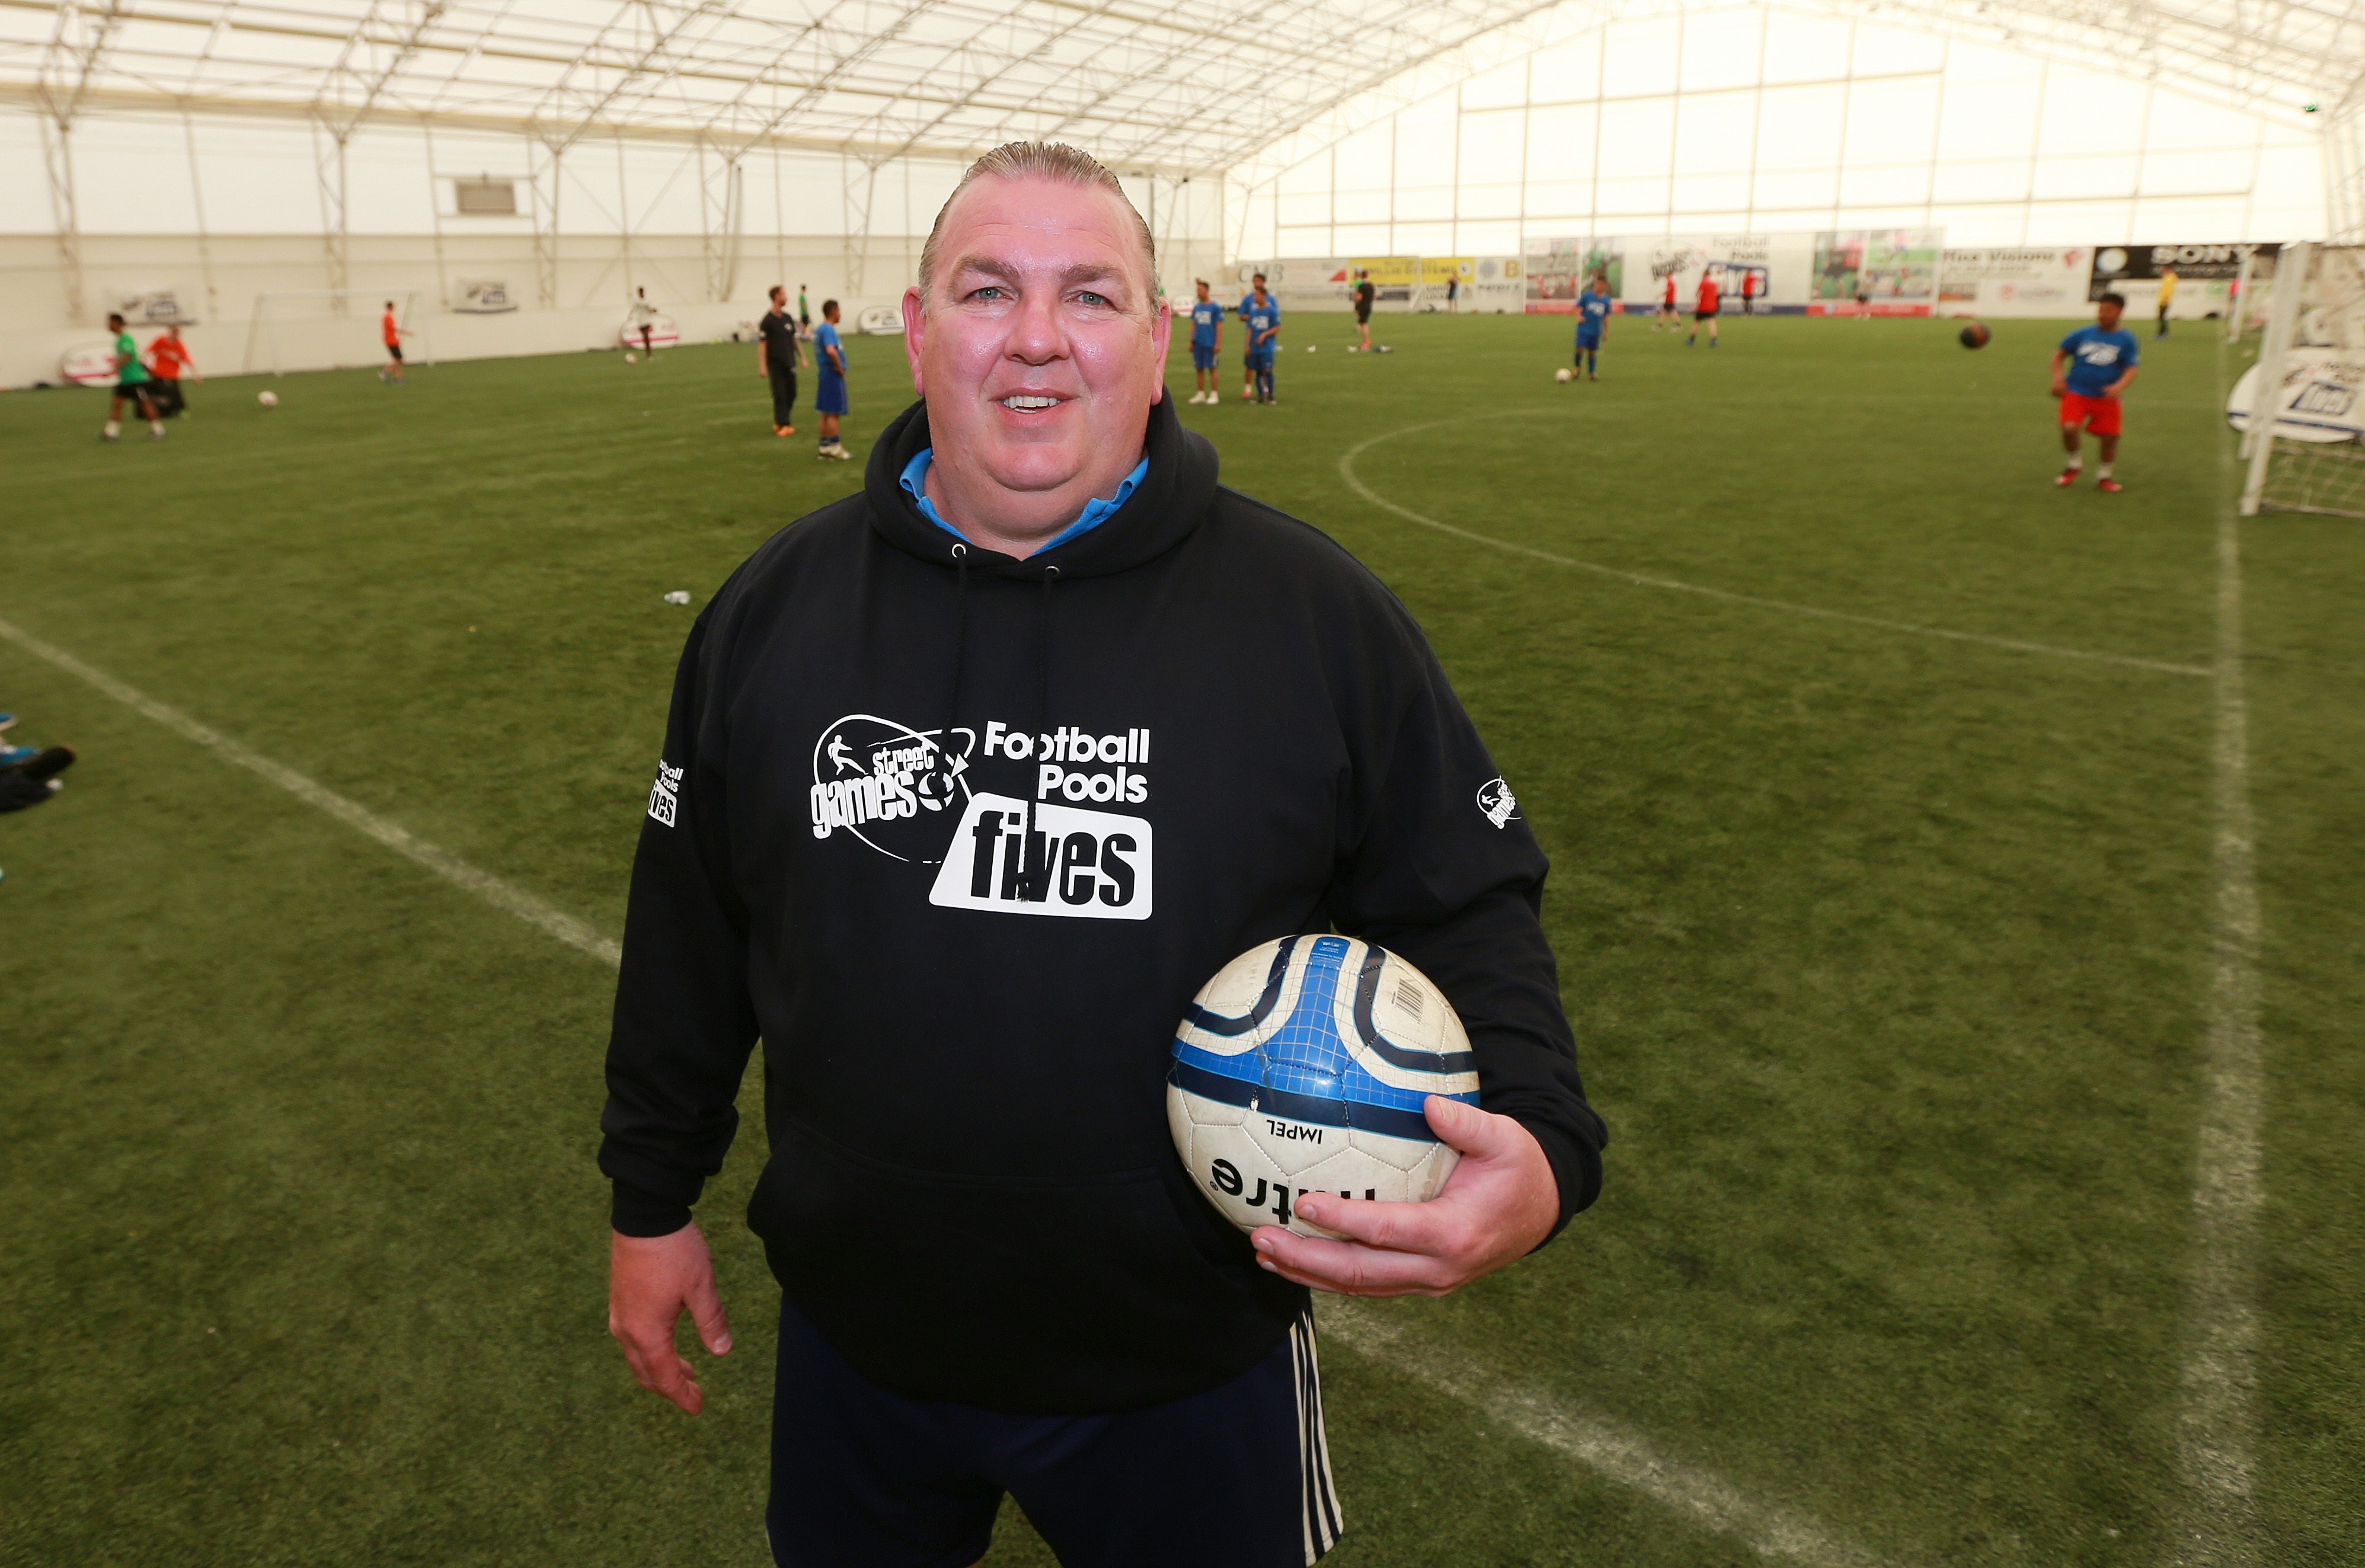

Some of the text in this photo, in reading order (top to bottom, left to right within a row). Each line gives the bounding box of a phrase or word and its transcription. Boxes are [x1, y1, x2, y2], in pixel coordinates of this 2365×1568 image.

[2150, 244, 2257, 264] SONY
[872, 741, 935, 777] street
[983, 720, 1150, 764] Football
[660, 771, 679, 792] Pools
[1037, 764, 1149, 804] Pools
[649, 783, 674, 822] ives
[810, 770, 918, 840] games
[970, 809, 1138, 907] fives
[1265, 1119, 1323, 1145] IMPEL
[1211, 1158, 1376, 1225] tre
